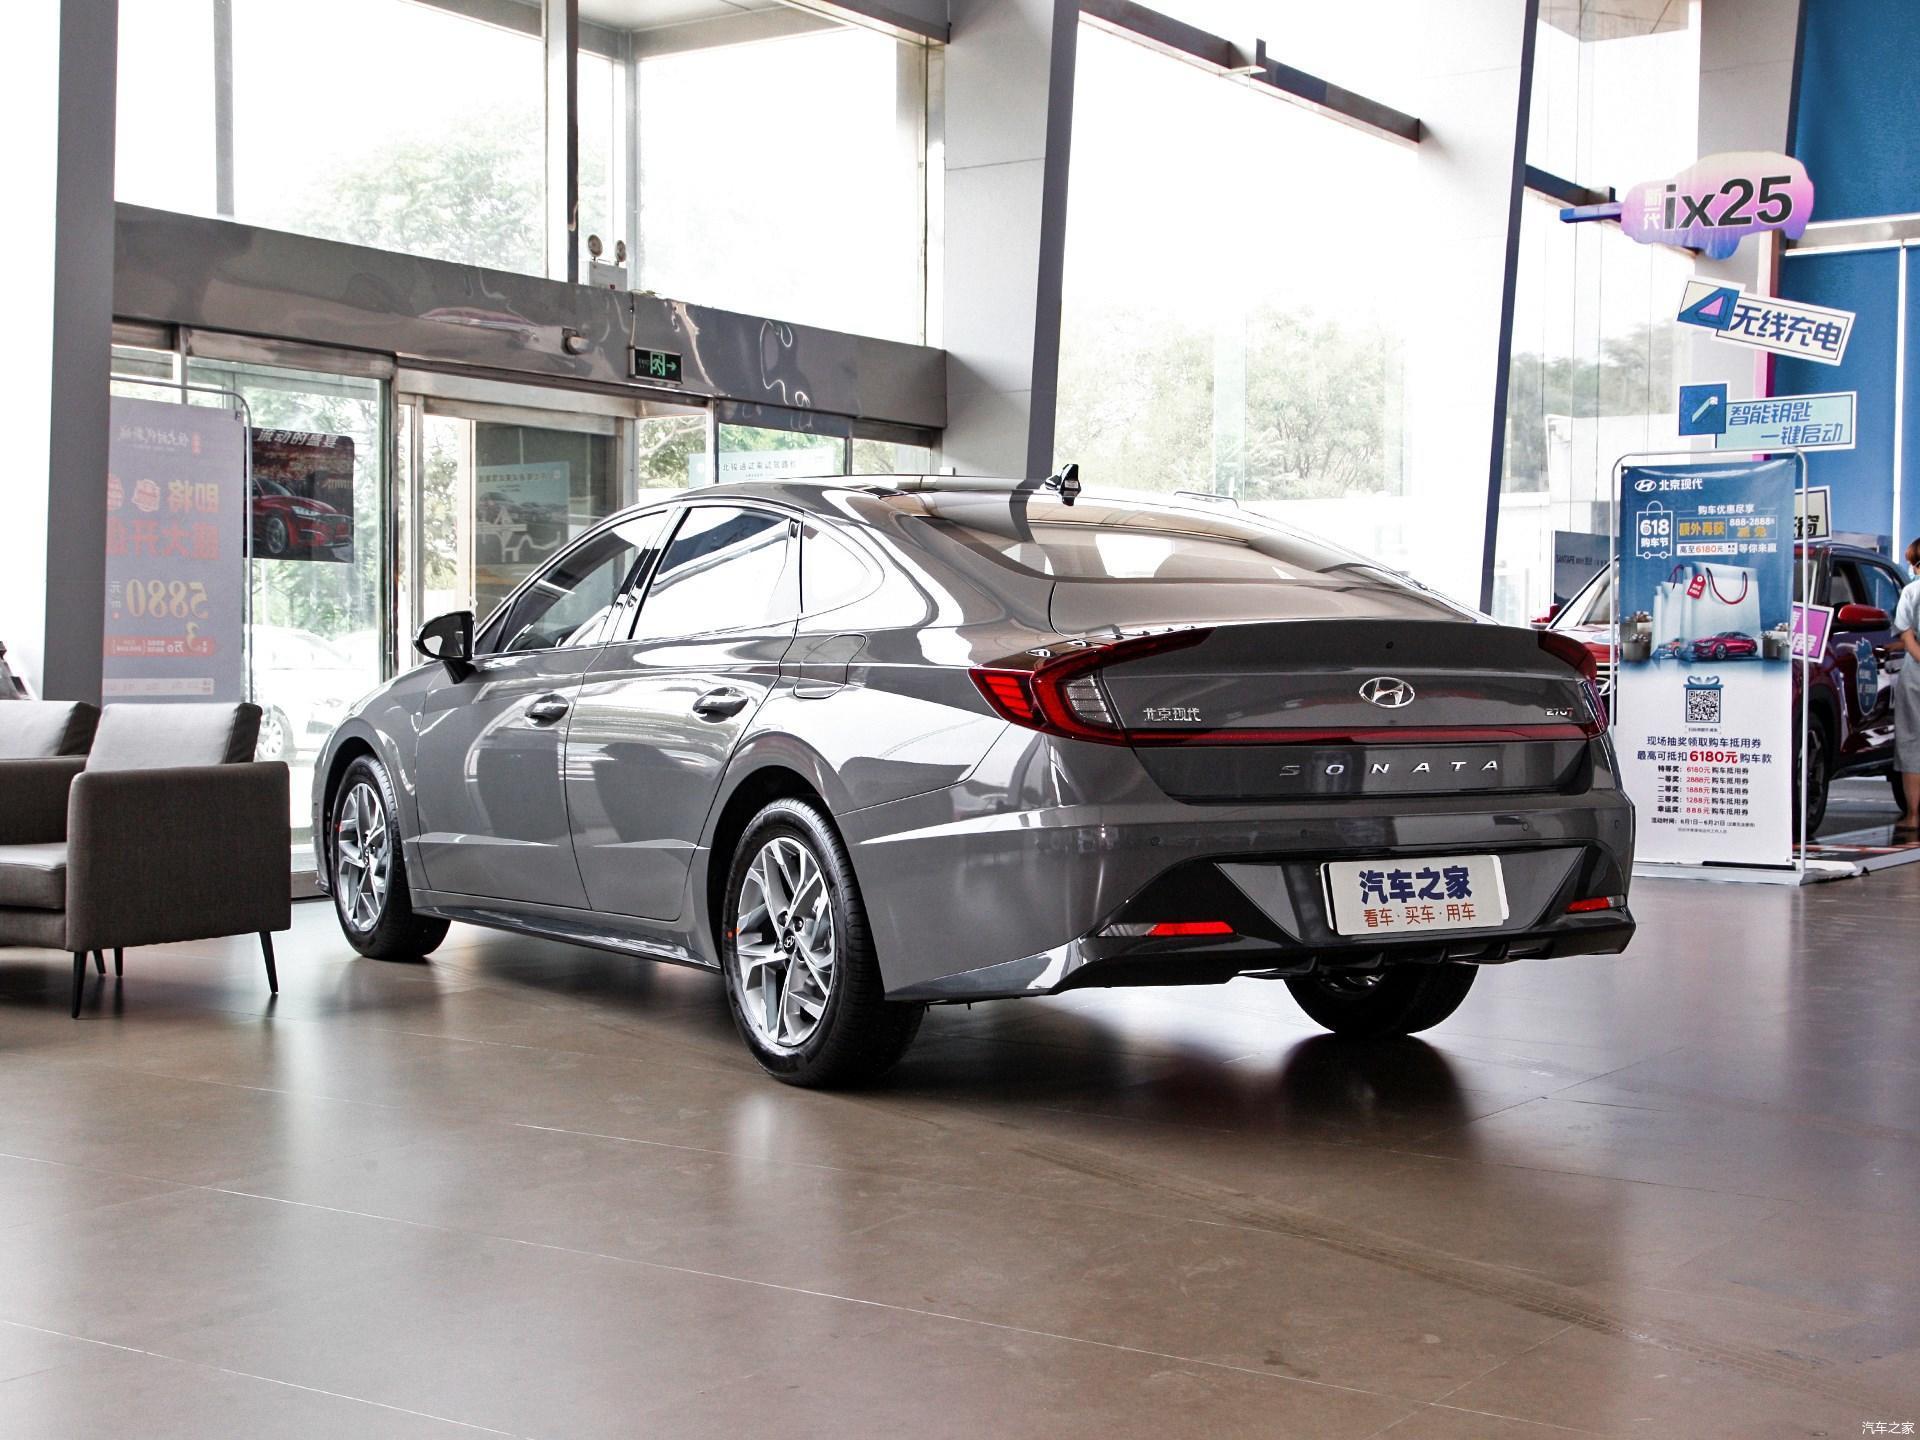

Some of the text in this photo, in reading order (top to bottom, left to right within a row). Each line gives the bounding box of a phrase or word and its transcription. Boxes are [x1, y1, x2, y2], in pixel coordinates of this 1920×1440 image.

[1663, 175, 1793, 230] ix25
[1730, 304, 1842, 352] 无线充电
[1729, 401, 1813, 426] 智能钥匙
[1761, 422, 1843, 445] 一键启动
[1659, 478, 1703, 491] 北京现代
[1697, 504, 1755, 515] 购车优惠尽享
[1640, 519, 1670, 536] 618
[1640, 537, 1669, 548] 购车节
[1142, 707, 1201, 722] 北京现代
[1647, 736, 1761, 748] 现场抽奖领取购车抵用券
[1279, 760, 1499, 776] SONATA
[1358, 865, 1472, 904] 汽车之家
